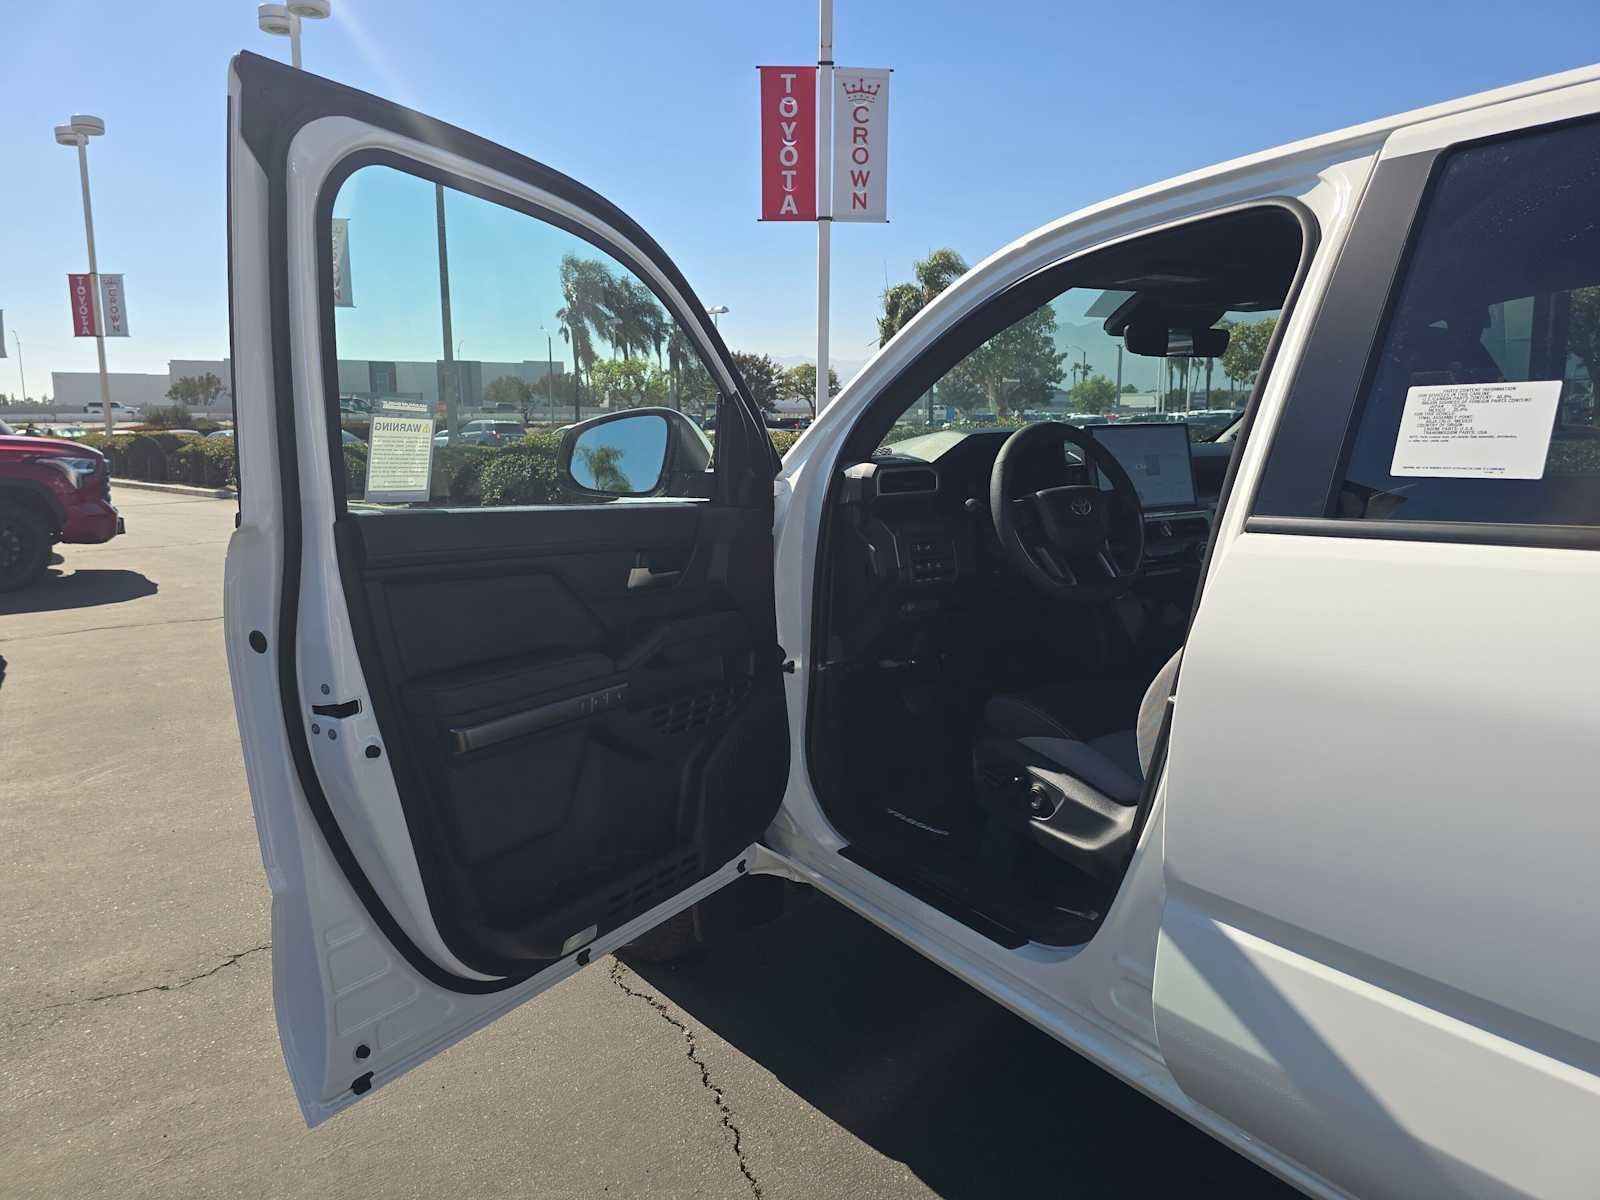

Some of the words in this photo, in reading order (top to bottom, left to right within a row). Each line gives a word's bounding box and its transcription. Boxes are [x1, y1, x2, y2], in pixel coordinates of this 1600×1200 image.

[779, 74, 799, 215] TOYOTA
[850, 106, 870, 210] CROWN
[76, 276, 91, 335] TOYOTA
